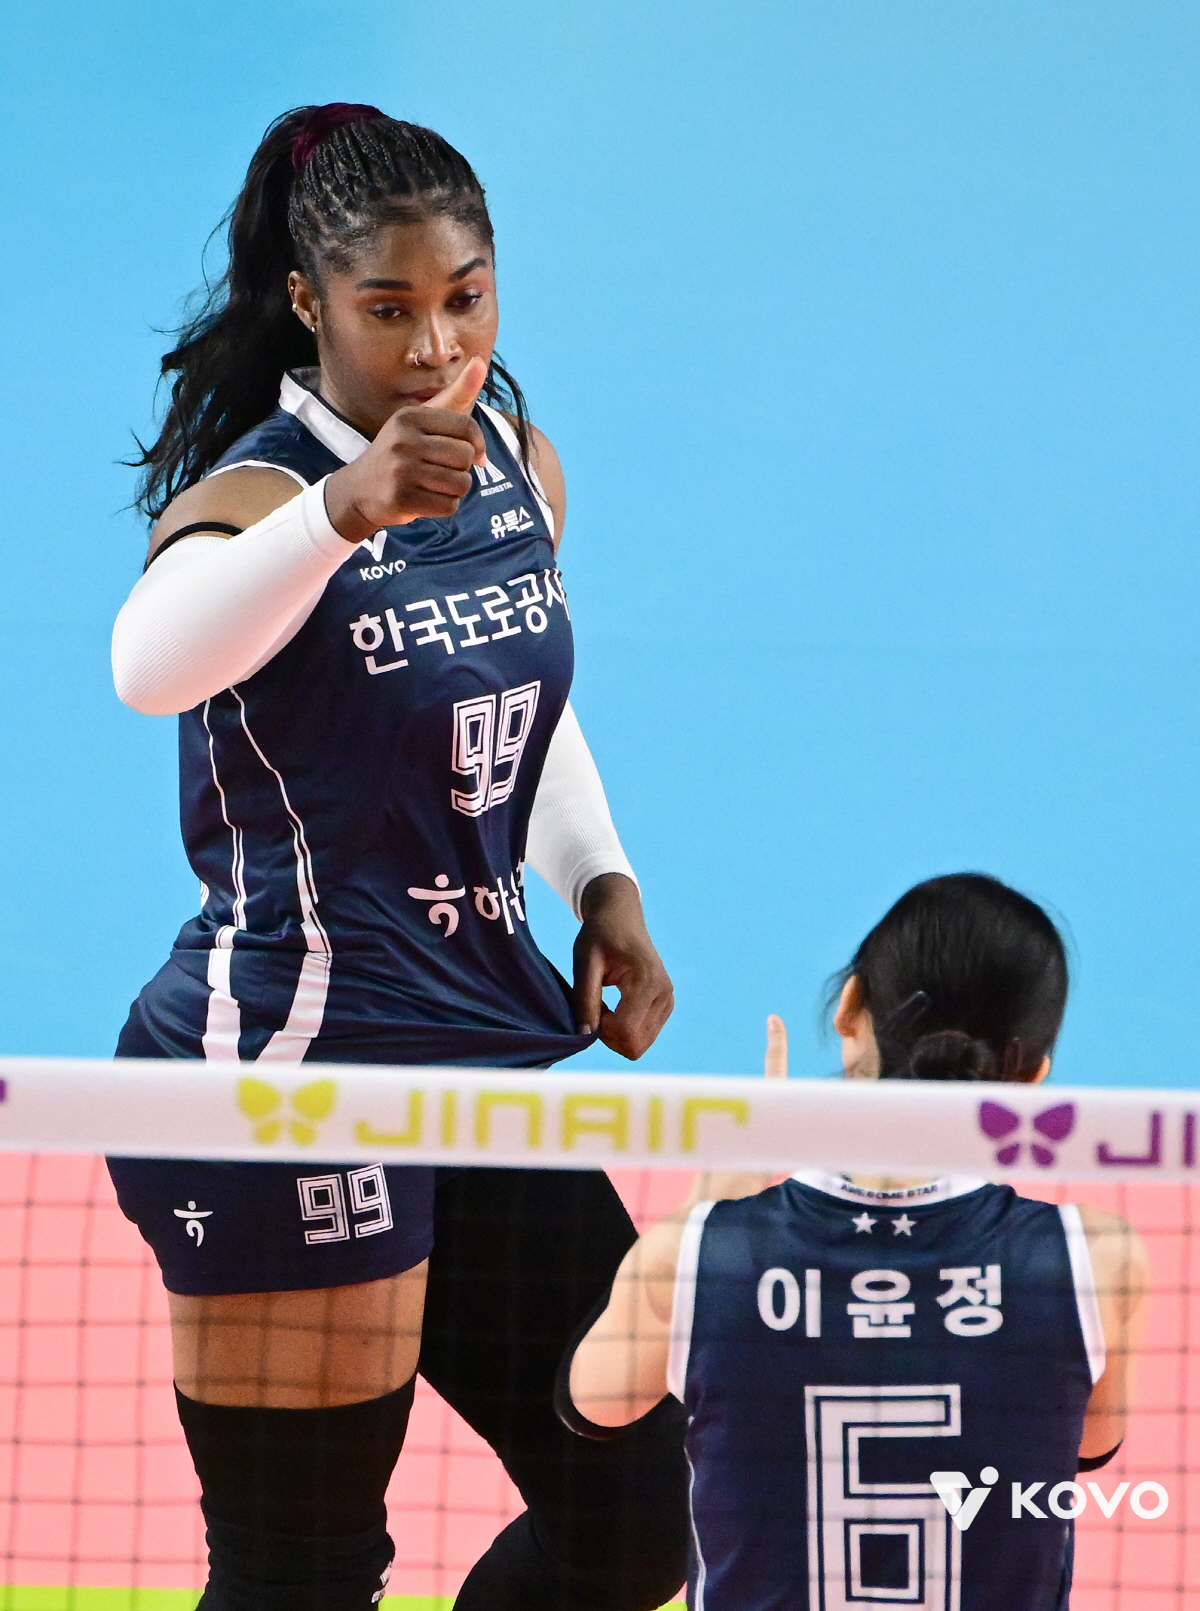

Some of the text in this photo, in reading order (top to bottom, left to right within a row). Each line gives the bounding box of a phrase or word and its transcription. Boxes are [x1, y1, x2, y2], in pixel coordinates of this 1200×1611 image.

[491, 506, 535, 539] 유록스
[359, 559, 407, 581] KOVO
[451, 680, 541, 817] 99
[297, 1163, 394, 1245] 99
[757, 1265, 1004, 1339] 이윤정
[804, 1384, 962, 1611] 6
